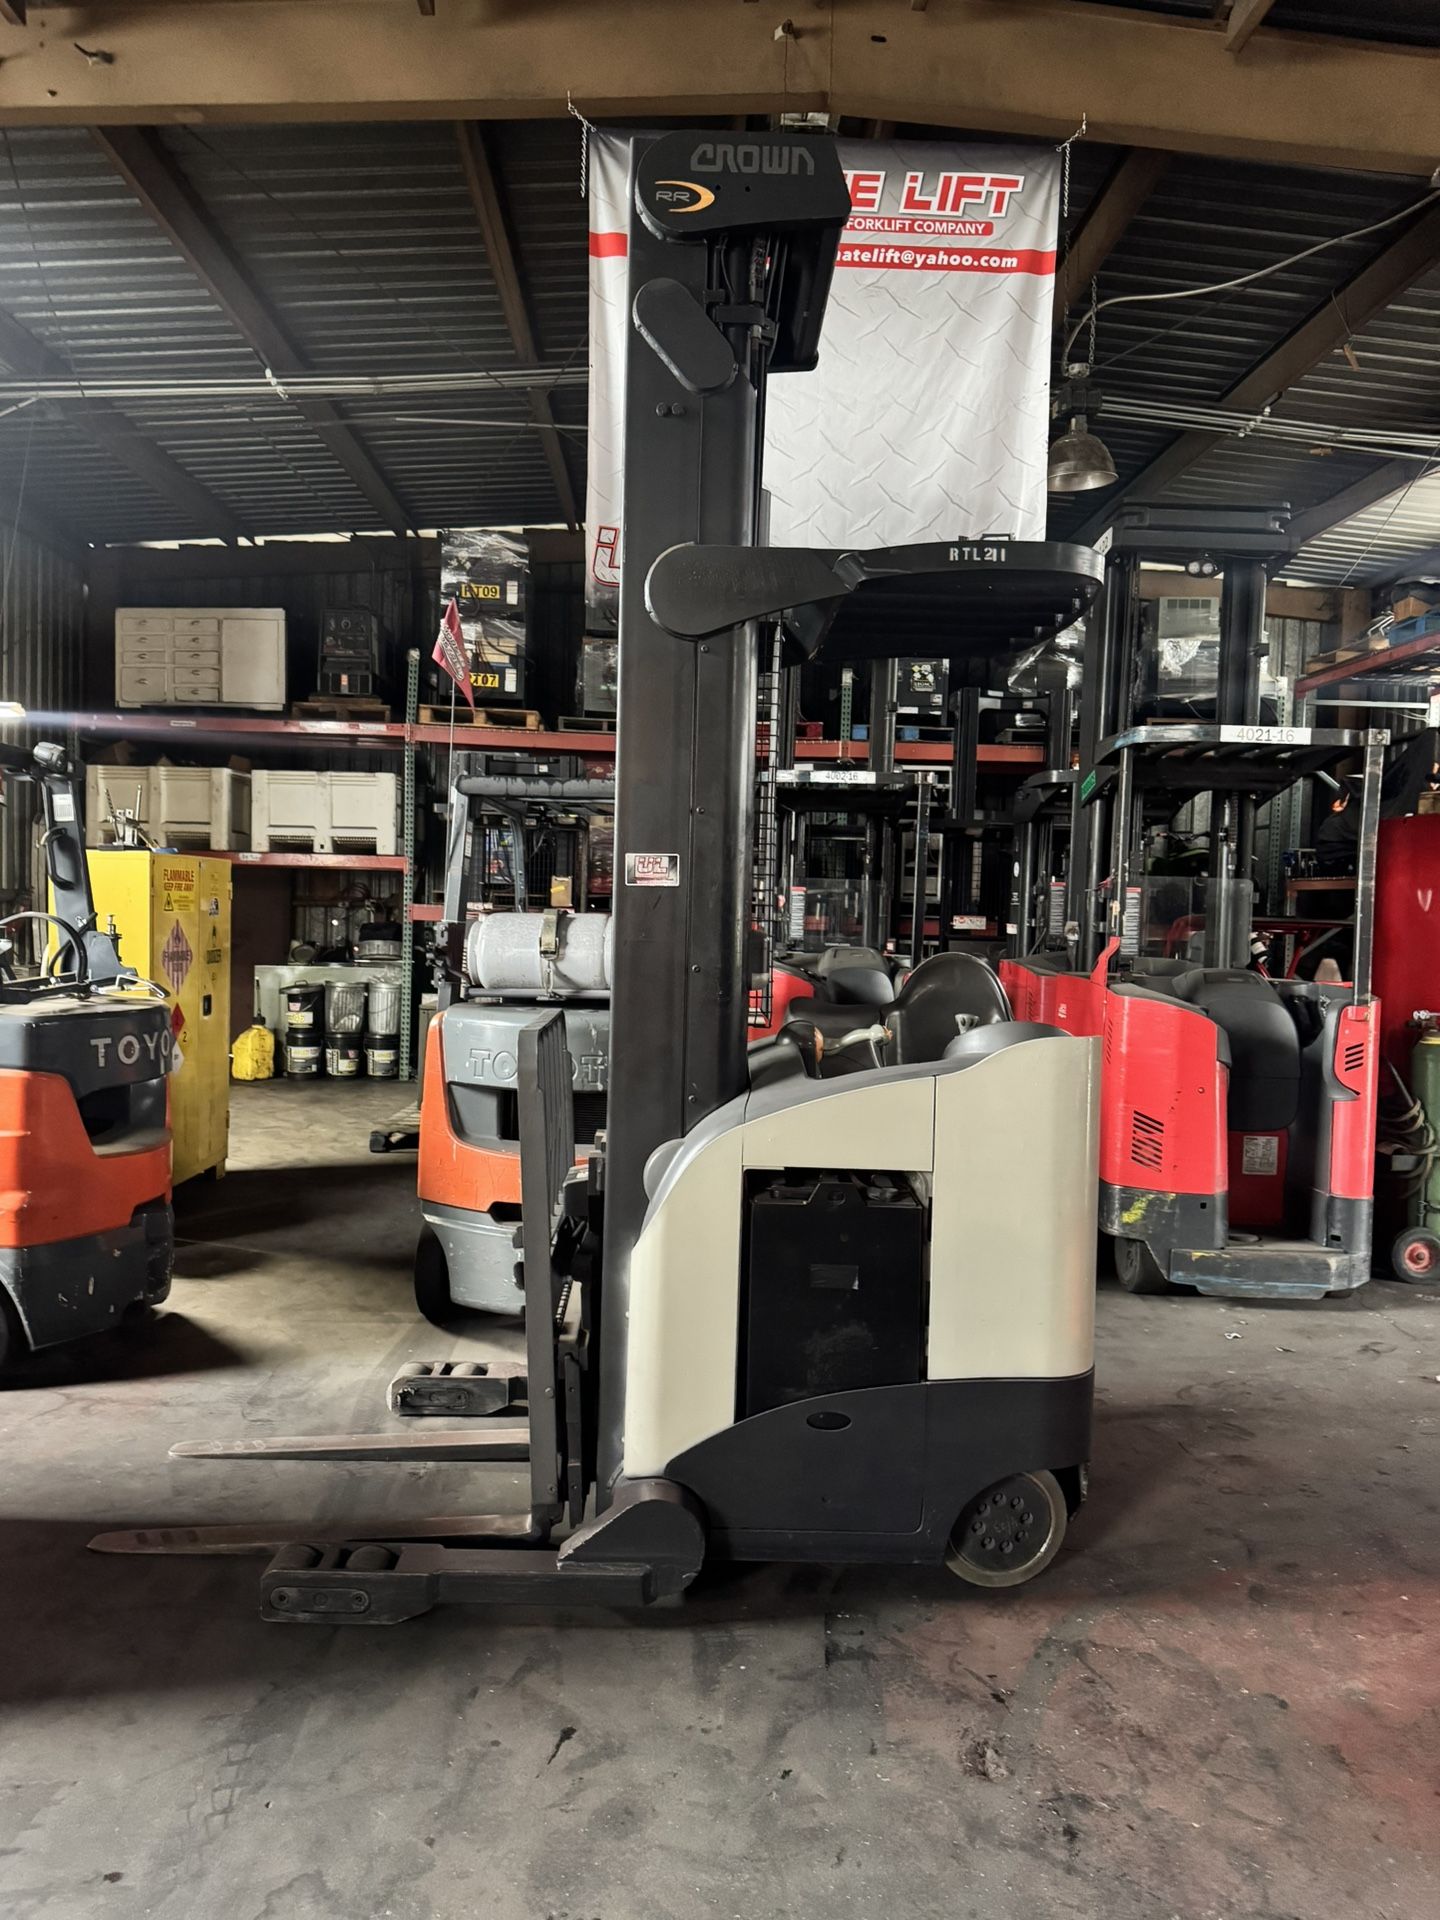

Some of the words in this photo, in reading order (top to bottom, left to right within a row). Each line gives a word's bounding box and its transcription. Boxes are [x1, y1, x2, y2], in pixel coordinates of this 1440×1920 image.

[690, 143, 815, 176] CROWN
[656, 191, 690, 202] RR
[899, 171, 1025, 218] LIFT
[846, 217, 910, 232] FORKLIFT
[913, 221, 986, 235] COMPANY
[1236, 727, 1295, 742] 4021-16
[163, 868, 195, 882] FLAMMABLE
